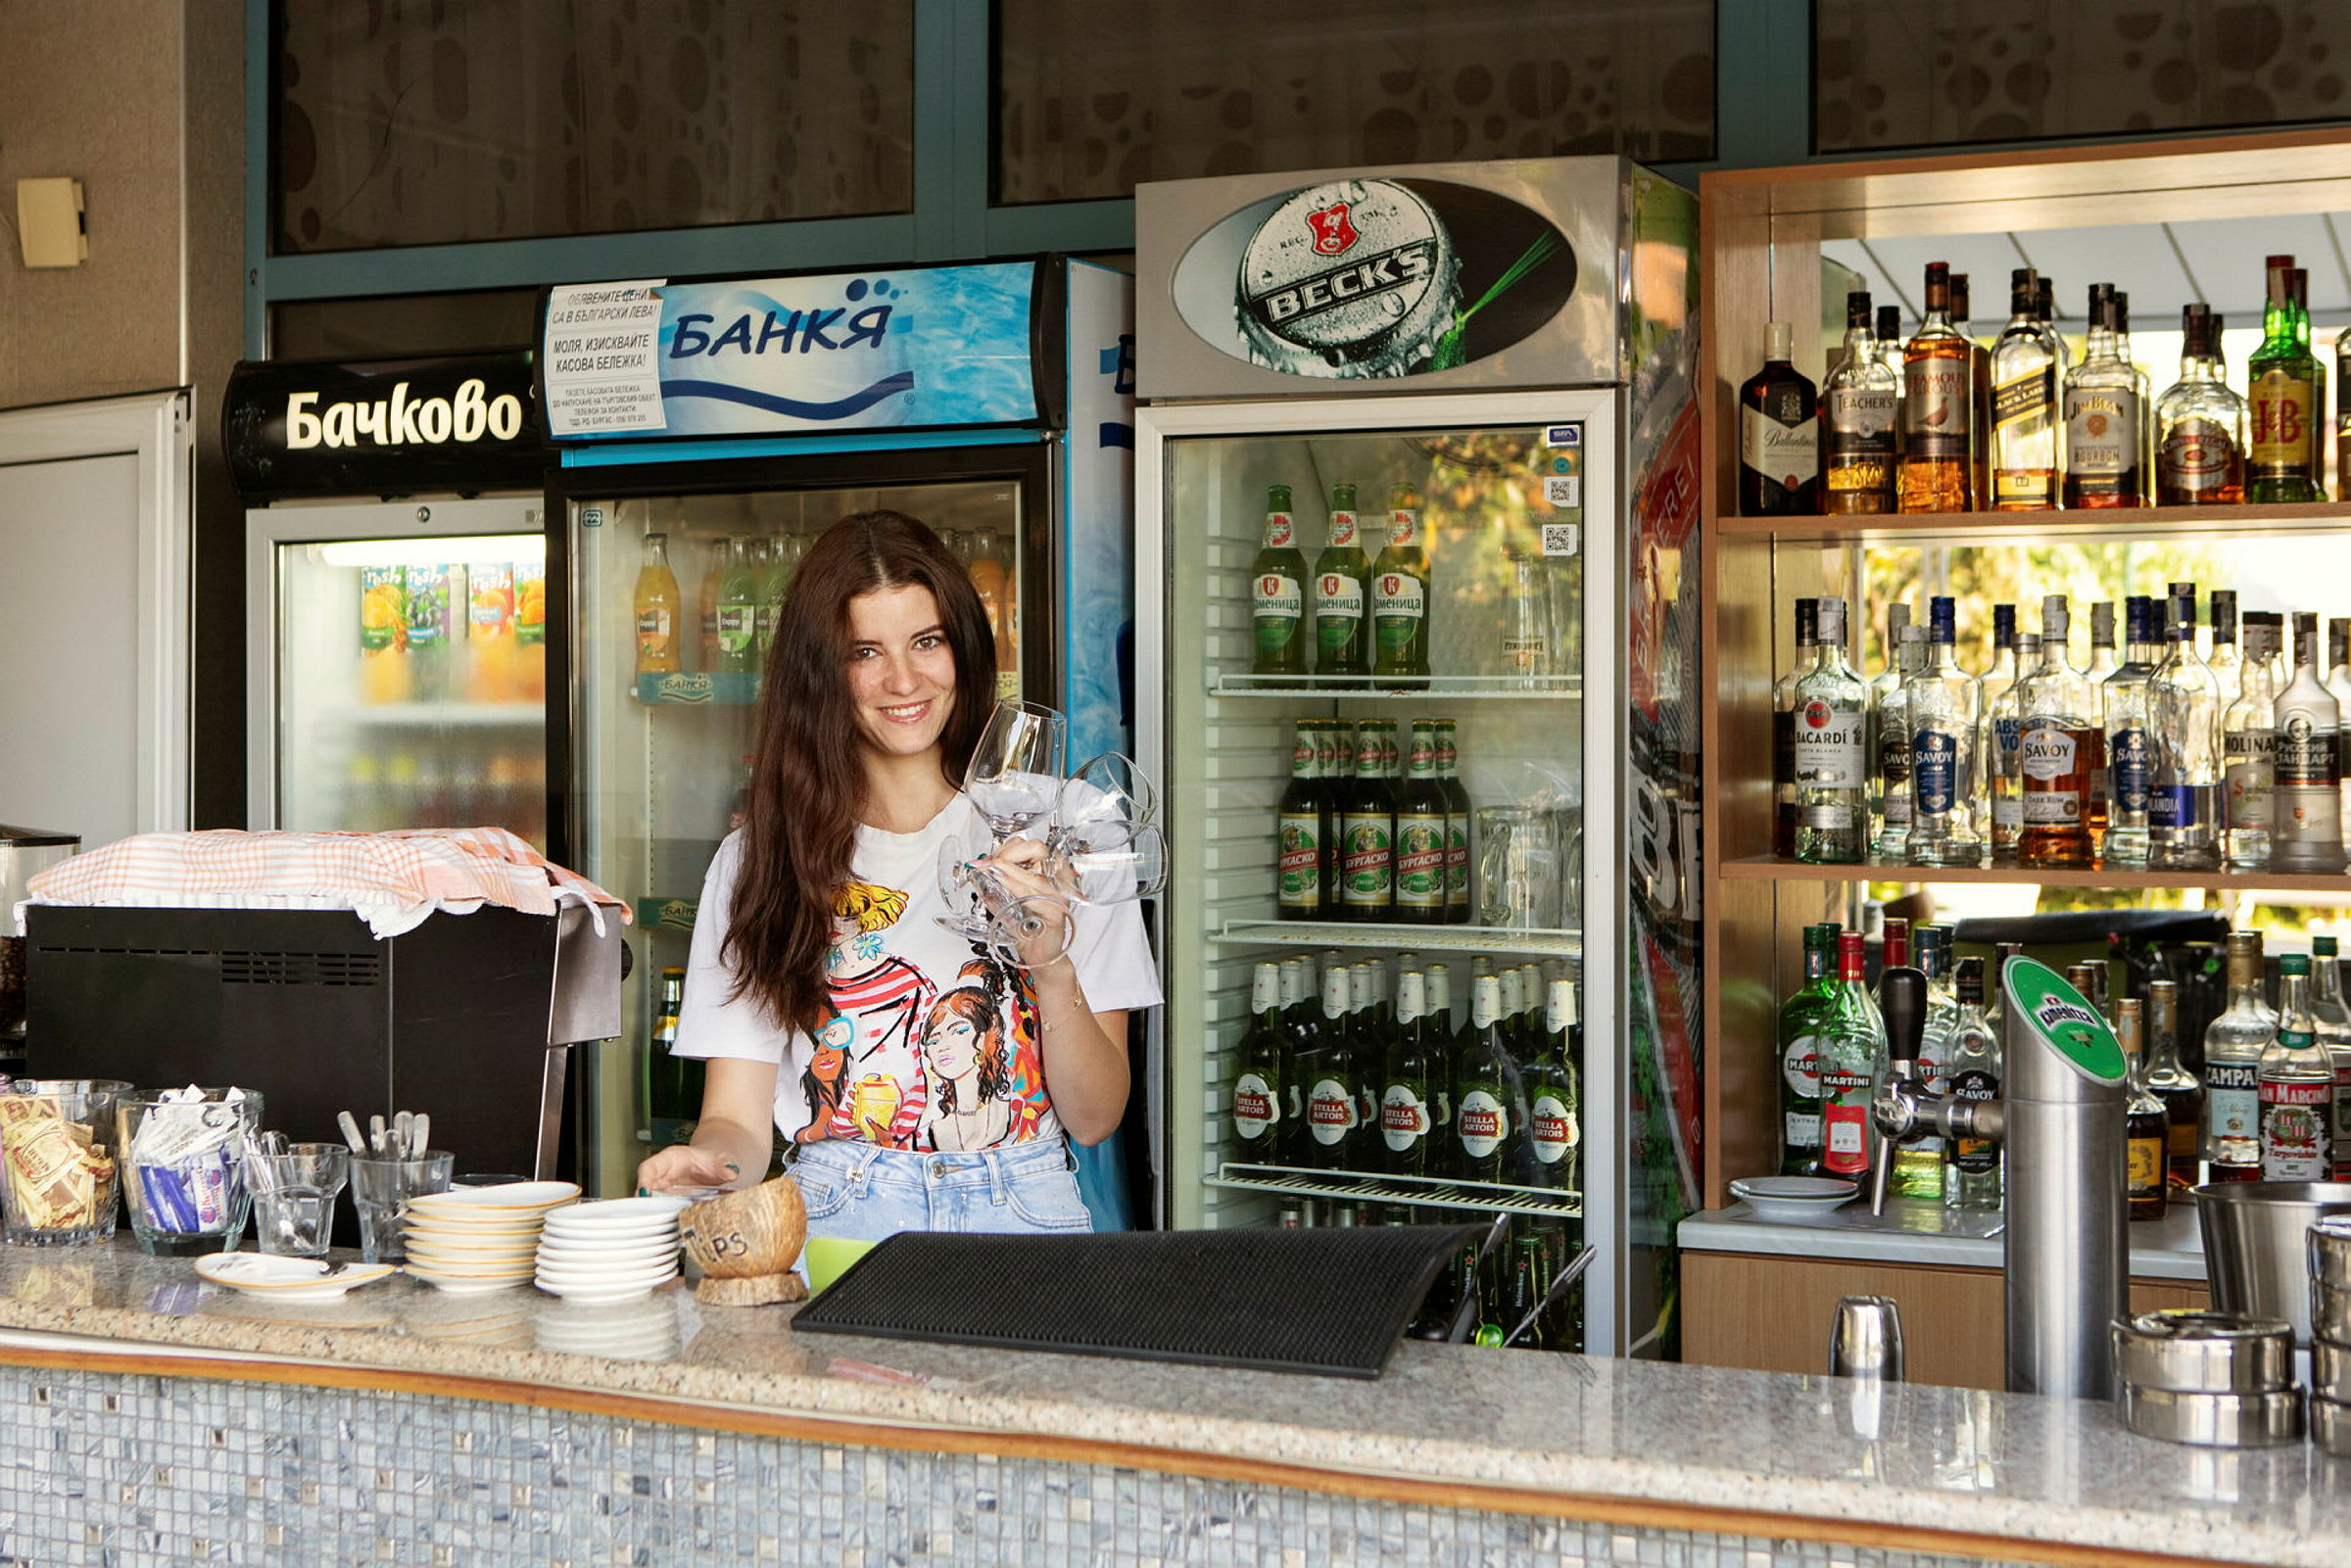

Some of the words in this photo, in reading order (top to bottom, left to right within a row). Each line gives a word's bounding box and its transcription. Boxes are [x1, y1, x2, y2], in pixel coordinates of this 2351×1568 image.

[1265, 245, 1429, 325] BECK'S
[568, 291, 622, 306] ОБЯВЕНИТЕ
[623, 289, 648, 303] ЦЕНИ
[552, 311, 564, 324] СА
[566, 310, 573, 323] В
[575, 307, 629, 322] БЪЛГАРСКИ
[629, 305, 657, 318] ЛЕВА!
[669, 305, 892, 358] БАНКЯ
[553, 340, 583, 355] МОЛЯ,
[586, 333, 649, 351] ИЗИСКВАЙТЕ
[556, 357, 594, 373] КАСОВА
[597, 355, 647, 370] БЕЛЕЖКА!
[1837, 394, 1894, 413] TEACHER'S
[2070, 400, 2091, 420] JIM
[2092, 396, 2124, 418] BEAM
[287, 378, 523, 450] Бачково
[2075, 450, 2120, 462] BOURBON
[1254, 597, 1300, 612] аменица
[1374, 597, 1420, 612] аменица
[665, 679, 707, 690] БАНКЯ
[1995, 719, 2020, 734] ABS
[2000, 736, 2019, 750] VO
[2024, 742, 2071, 759] SAVOY
[2226, 736, 2274, 752] MOLINA
[1883, 752, 1910, 765] SAVO
[1916, 750, 1953, 766] SAVOY
[2116, 747, 2146, 763] SAVO
[1346, 851, 1389, 869] БУРГАСКО
[1399, 852, 1443, 870] БУРГАСКО
[664, 905, 696, 918] БАНК
[1823, 1076, 1869, 1086] MARTINI
[2207, 1067, 2257, 1086] CAMPA
[1237, 1097, 1265, 1107] STELLA
[1314, 1103, 1344, 1113] STELLA
[1237, 1106, 1266, 1115] ARTOIS
[1313, 1111, 1344, 1119] ARTOIS
[1385, 1109, 1413, 1118] STELLA
[1384, 1117, 1414, 1126] ARTOIS
[1463, 1116, 1495, 1124] STELLA
[1464, 1122, 1496, 1132] ARTOIS
[1535, 1120, 1563, 1130] STELLA
[1535, 1128, 1564, 1138] ARTOIS
